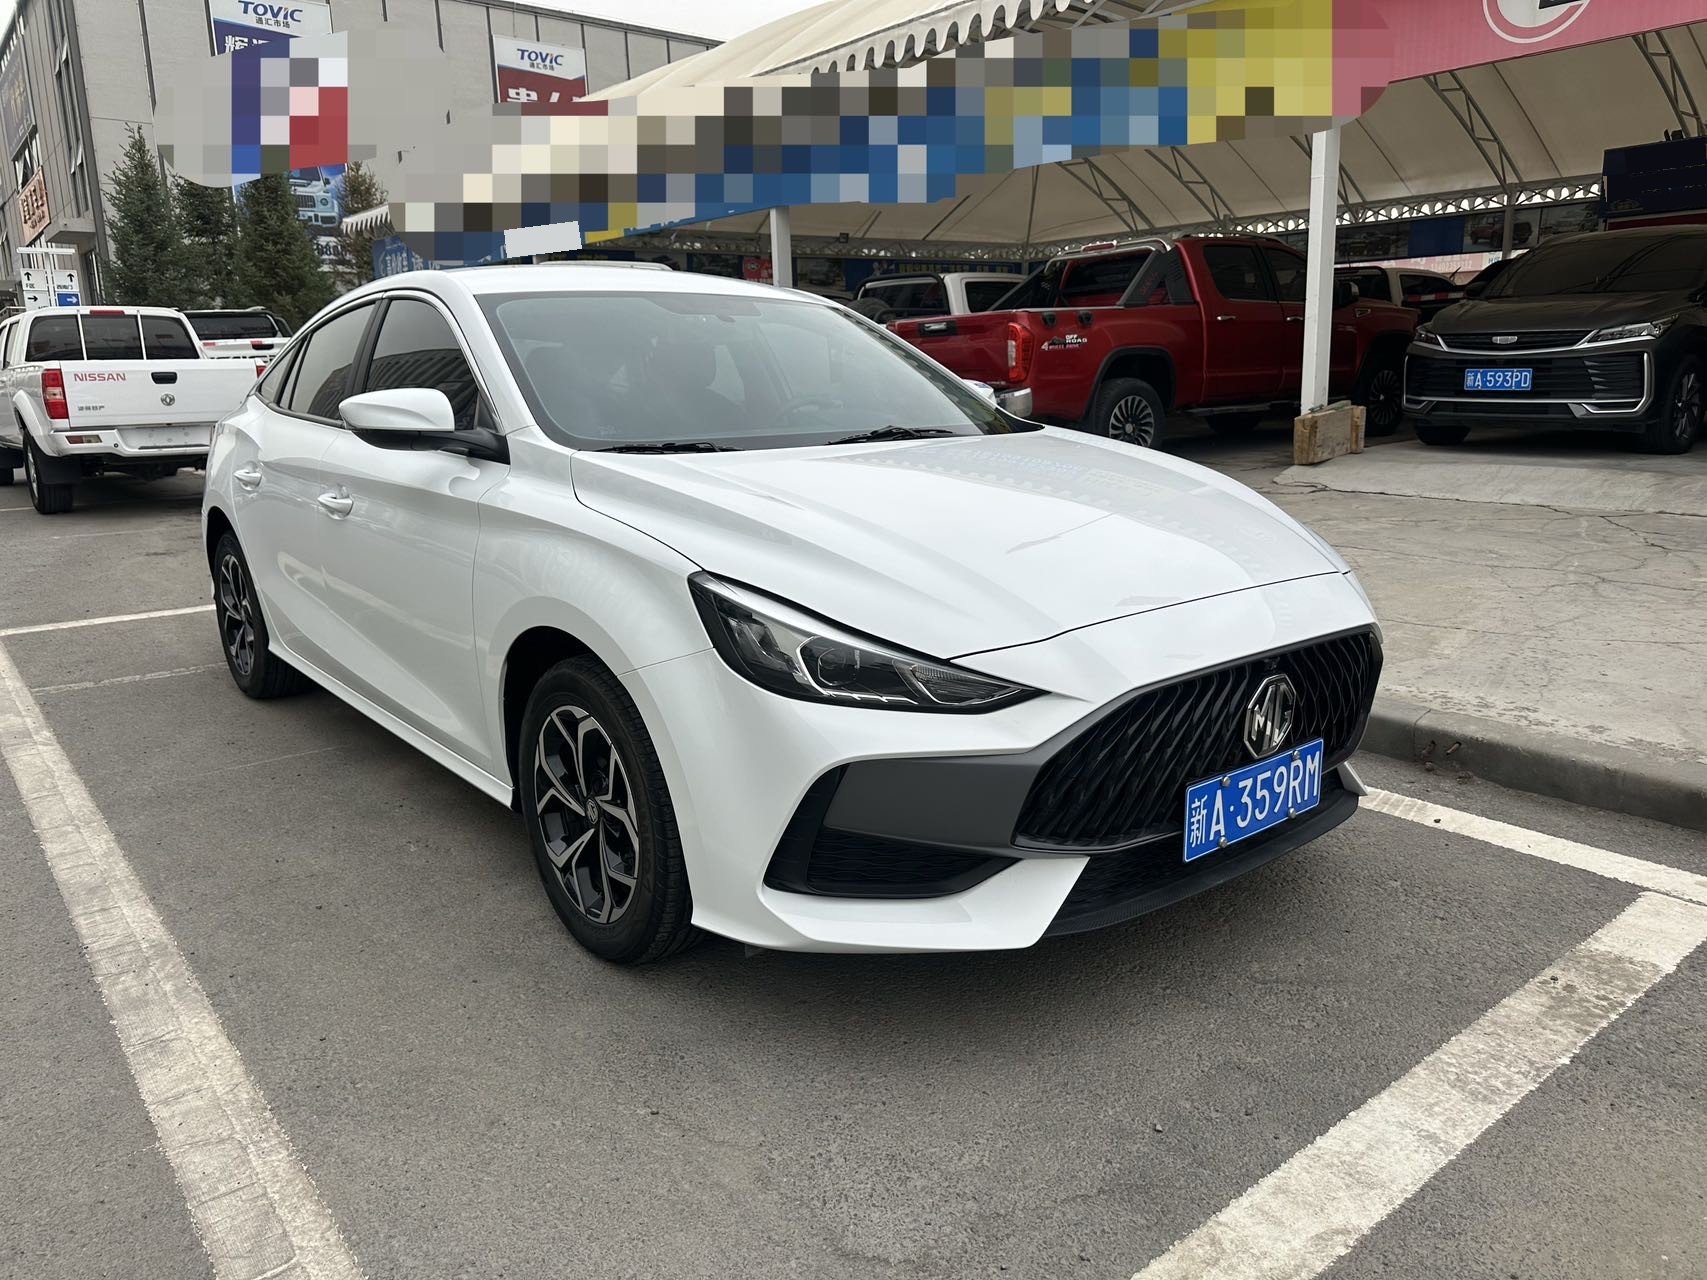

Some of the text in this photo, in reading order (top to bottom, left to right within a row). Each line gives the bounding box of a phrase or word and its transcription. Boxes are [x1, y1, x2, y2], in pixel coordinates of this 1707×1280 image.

[256, 16, 291, 28] 通汇市场
[74, 372, 126, 382] NISSAN
[1190, 751, 1320, 848] 新A·359RM
